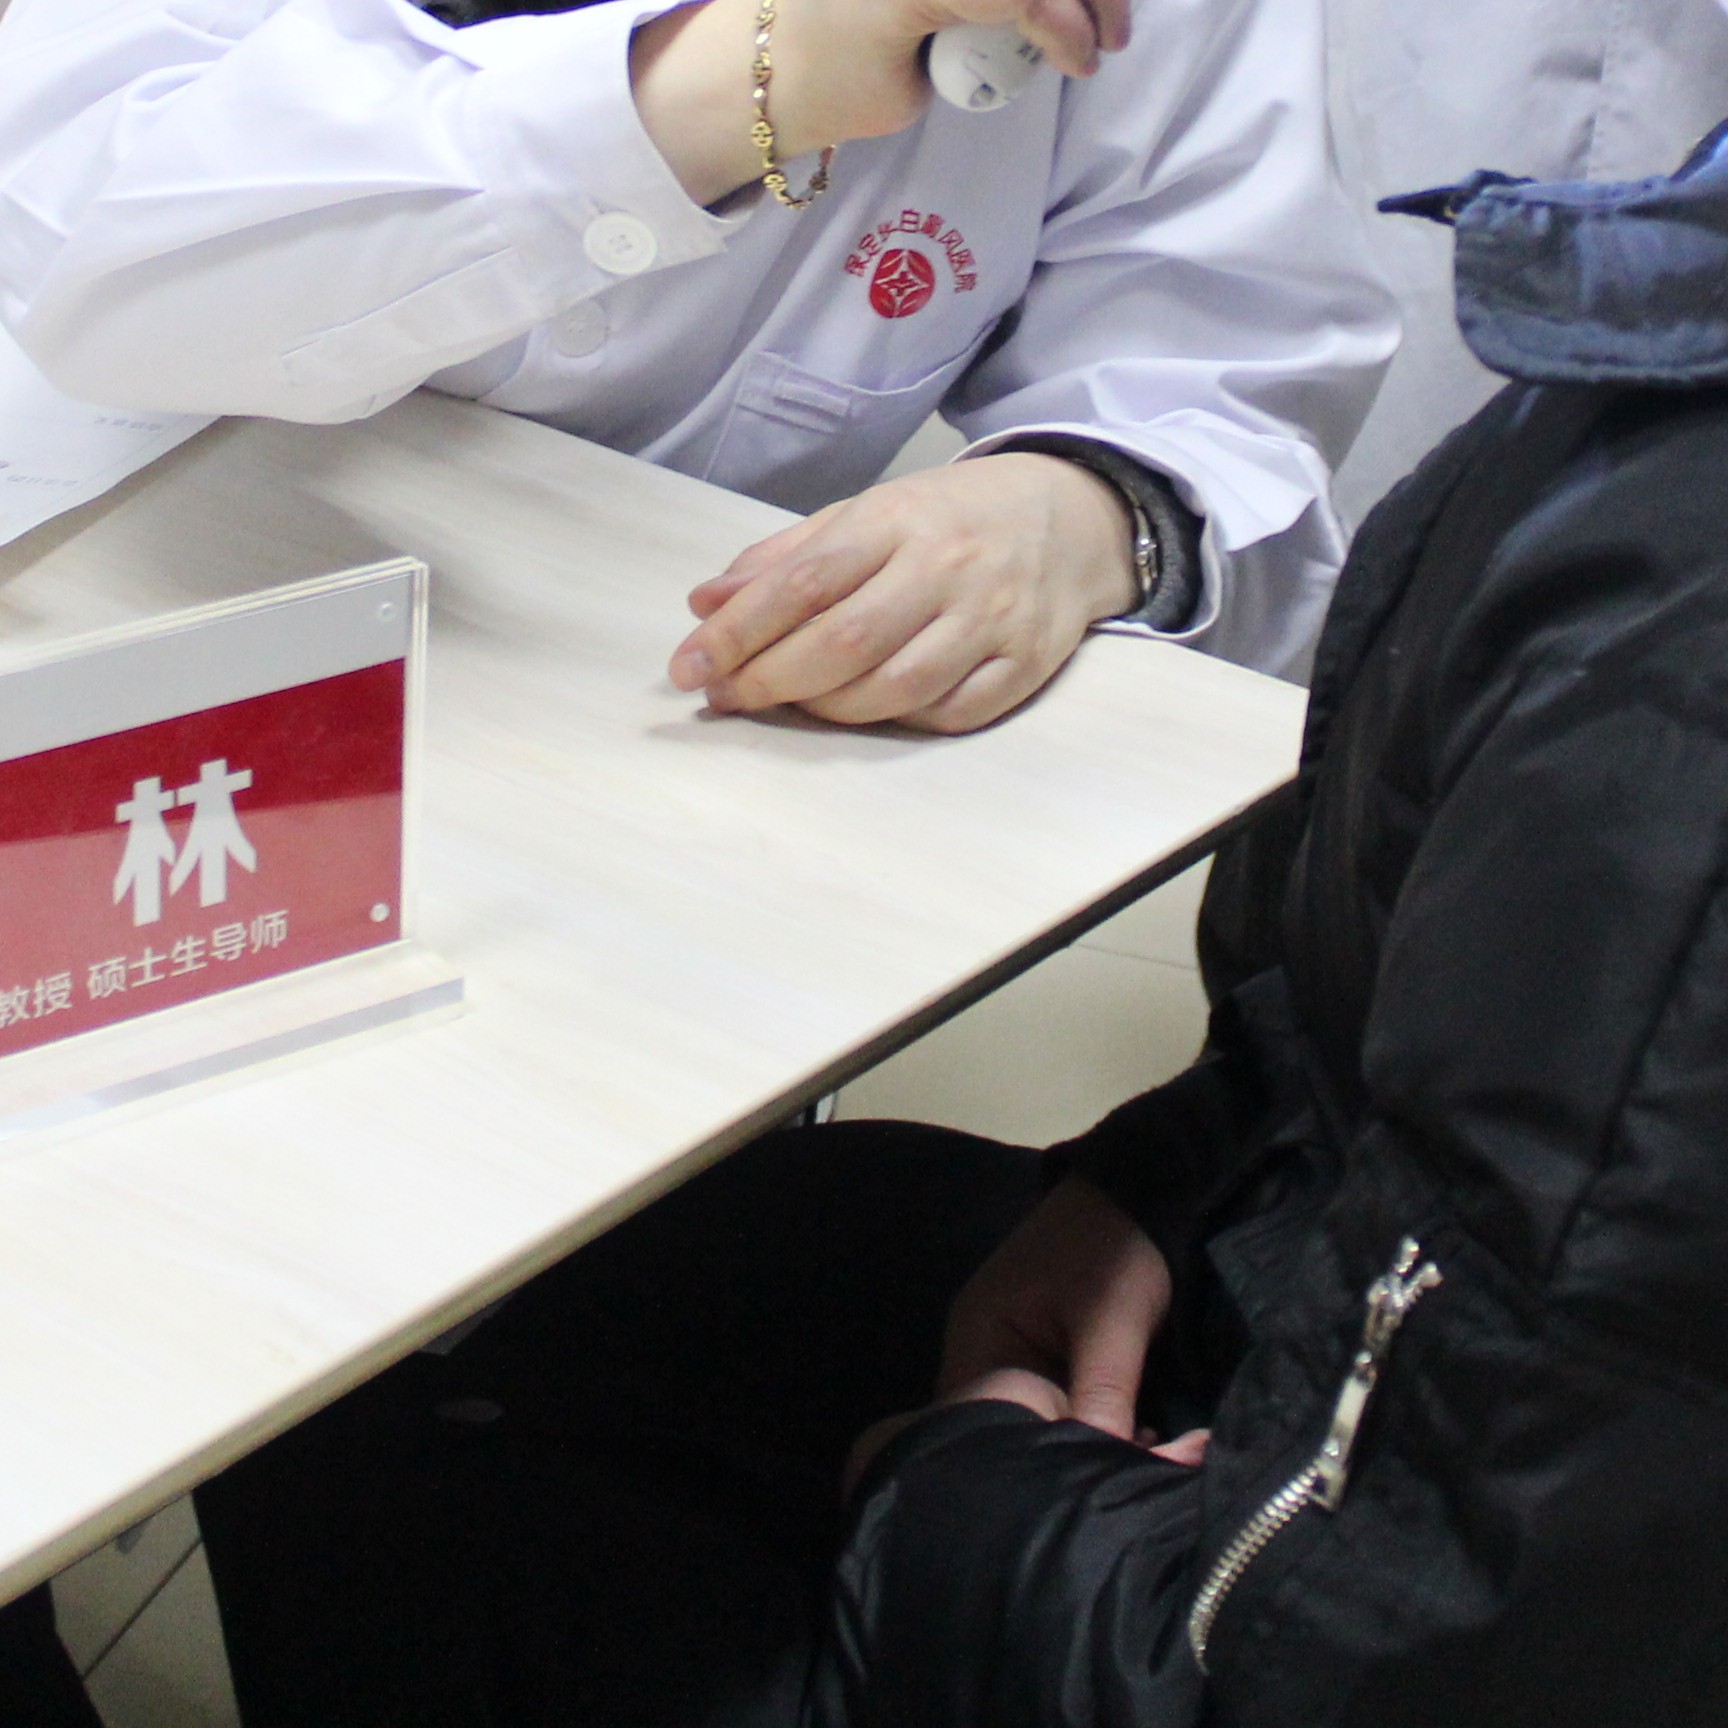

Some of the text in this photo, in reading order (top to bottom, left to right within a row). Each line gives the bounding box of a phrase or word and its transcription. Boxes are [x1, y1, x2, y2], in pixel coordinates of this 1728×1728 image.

[111, 758, 258, 929] 林
[85, 909, 290, 1000] 硕士生导师
